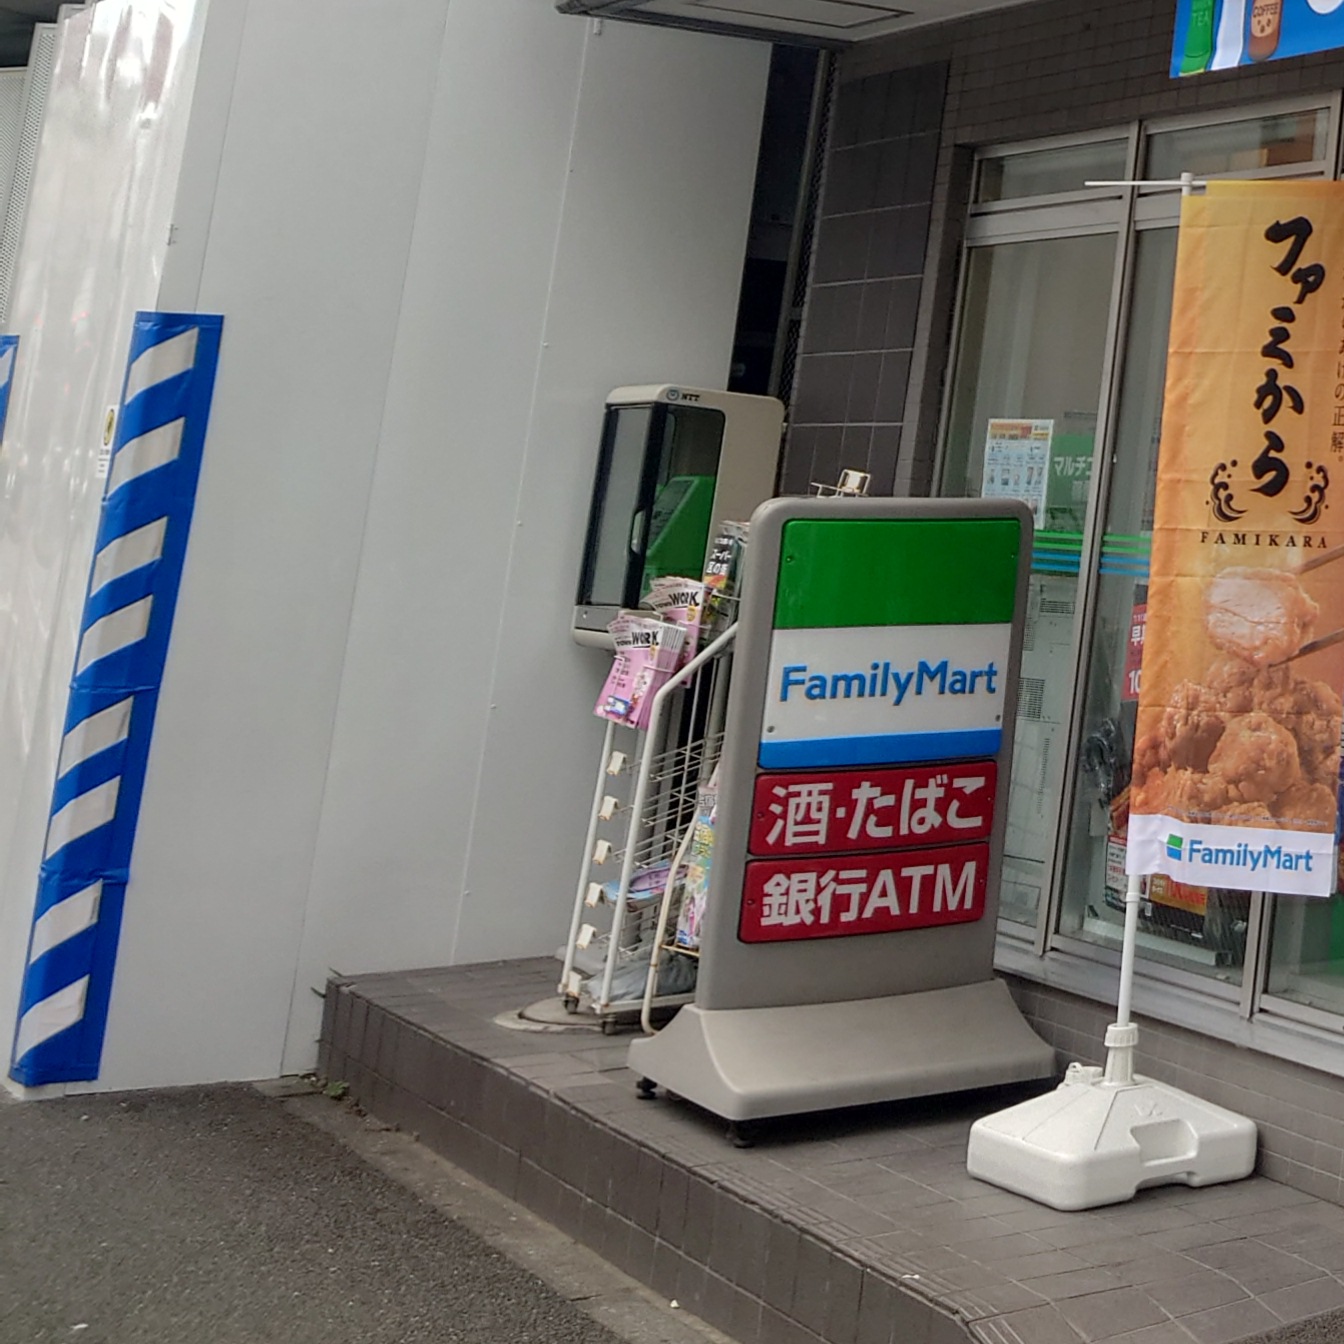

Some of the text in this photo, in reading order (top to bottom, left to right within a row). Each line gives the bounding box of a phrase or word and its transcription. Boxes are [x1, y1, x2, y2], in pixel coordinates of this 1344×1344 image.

[1253, 3, 1279, 18] COFFEE
[681, 394, 700, 402] NTT
[1200, 531, 1328, 550] FAMIKARA
[779, 660, 998, 704] FamilyMart
[765, 774, 987, 847] 酒・たばこ
[1188, 839, 1313, 874] FamilyMart
[761, 861, 977, 927] 銀行ATM
